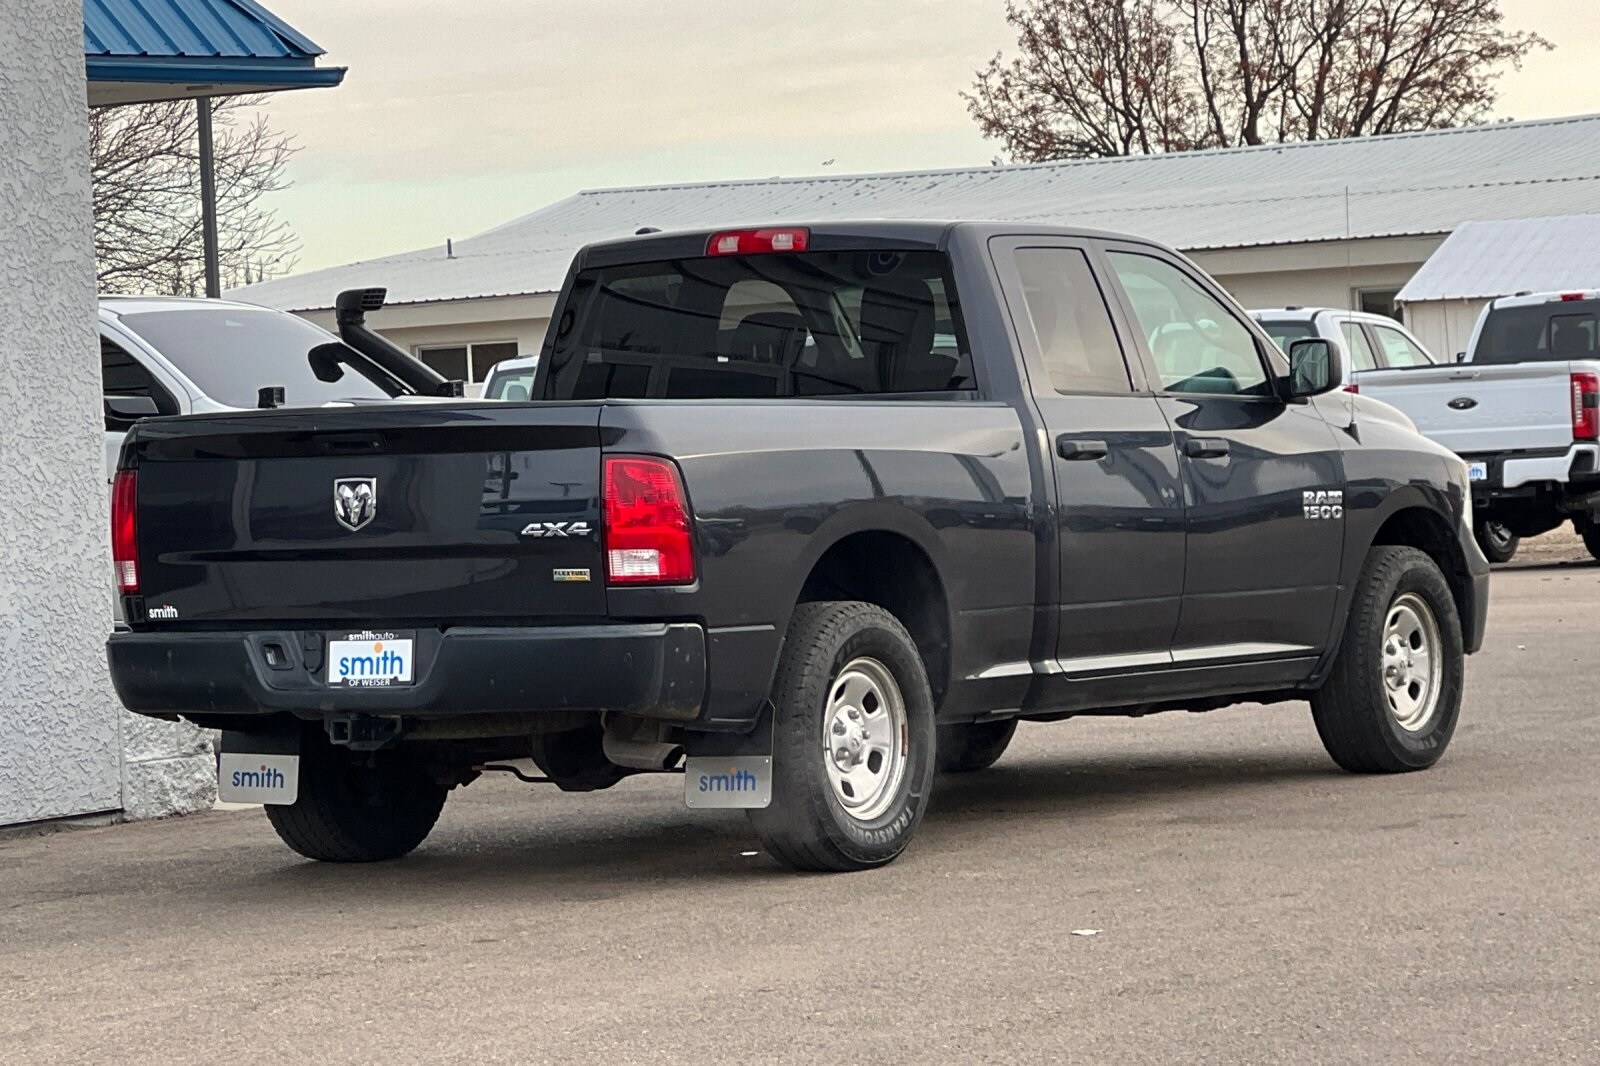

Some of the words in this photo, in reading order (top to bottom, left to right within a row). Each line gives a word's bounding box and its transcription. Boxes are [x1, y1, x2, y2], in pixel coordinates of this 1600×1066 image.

[1302, 490, 1343, 505] RAM
[1303, 505, 1343, 520] 1500
[149, 603, 179, 619] smith
[348, 630, 394, 641] smithauto
[339, 641, 403, 676] smith
[348, 679, 360, 687] OF
[361, 678, 391, 687] WEISER
[232, 764, 285, 789] smith
[699, 766, 757, 793] smith
